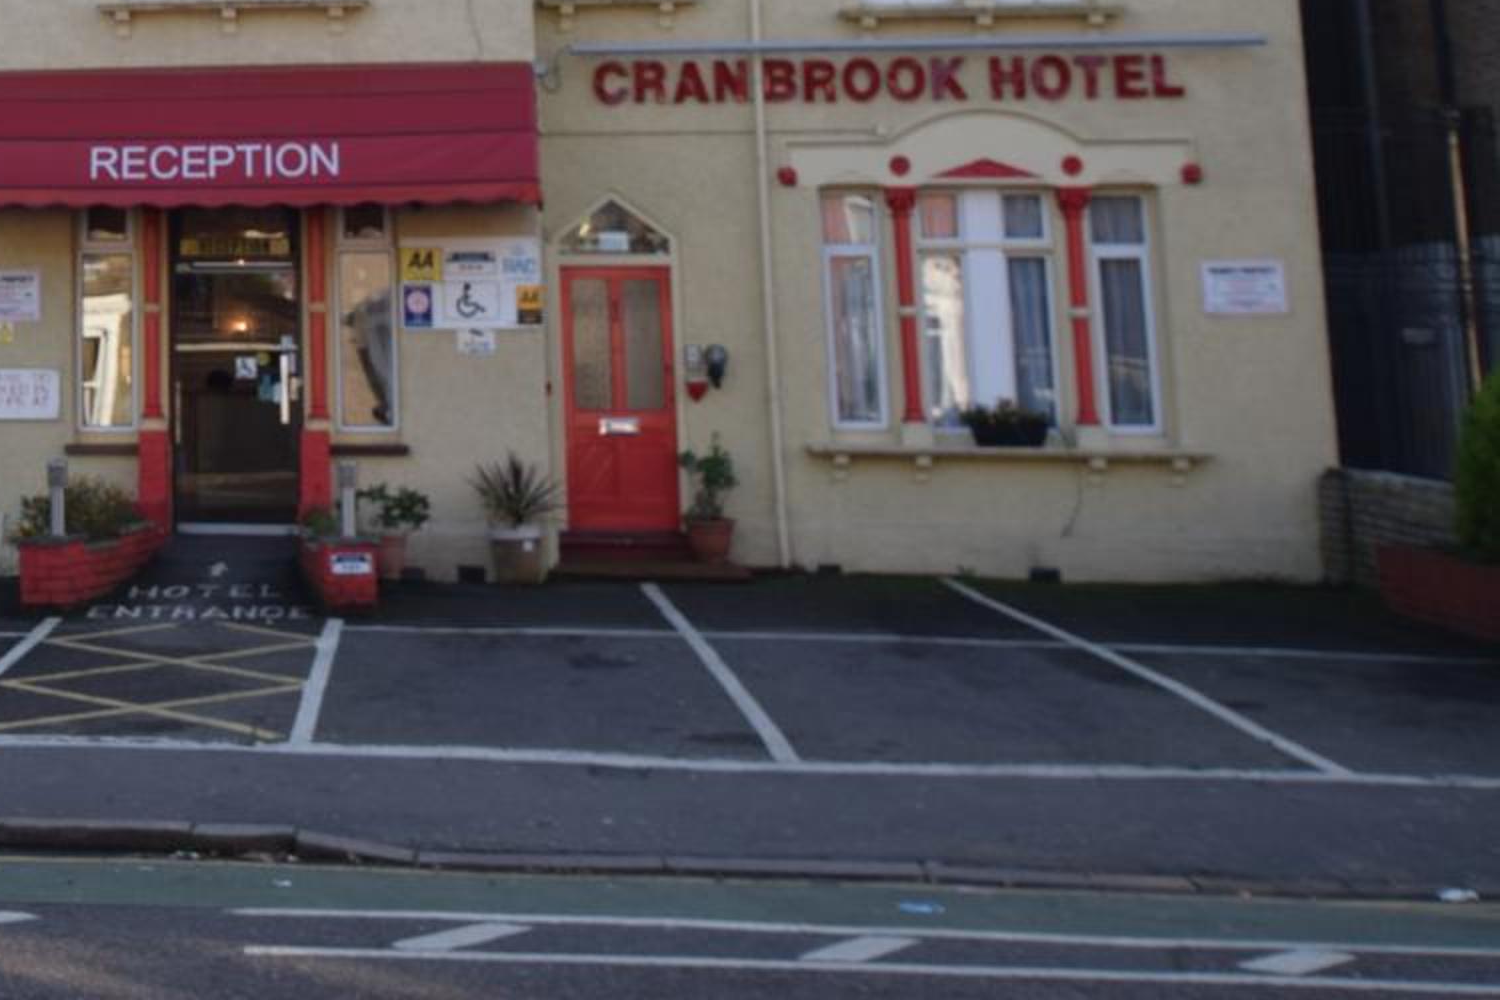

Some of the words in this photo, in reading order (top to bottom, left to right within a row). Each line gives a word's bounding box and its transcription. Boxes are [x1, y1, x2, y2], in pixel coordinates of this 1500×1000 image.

[592, 55, 966, 106] CRANBROOK
[989, 54, 1185, 100] HOTEL
[89, 142, 340, 180] RECEPTION
[407, 250, 434, 269] AA
[128, 583, 280, 599] HOTEL
[86, 604, 313, 621] ENTRANCE
